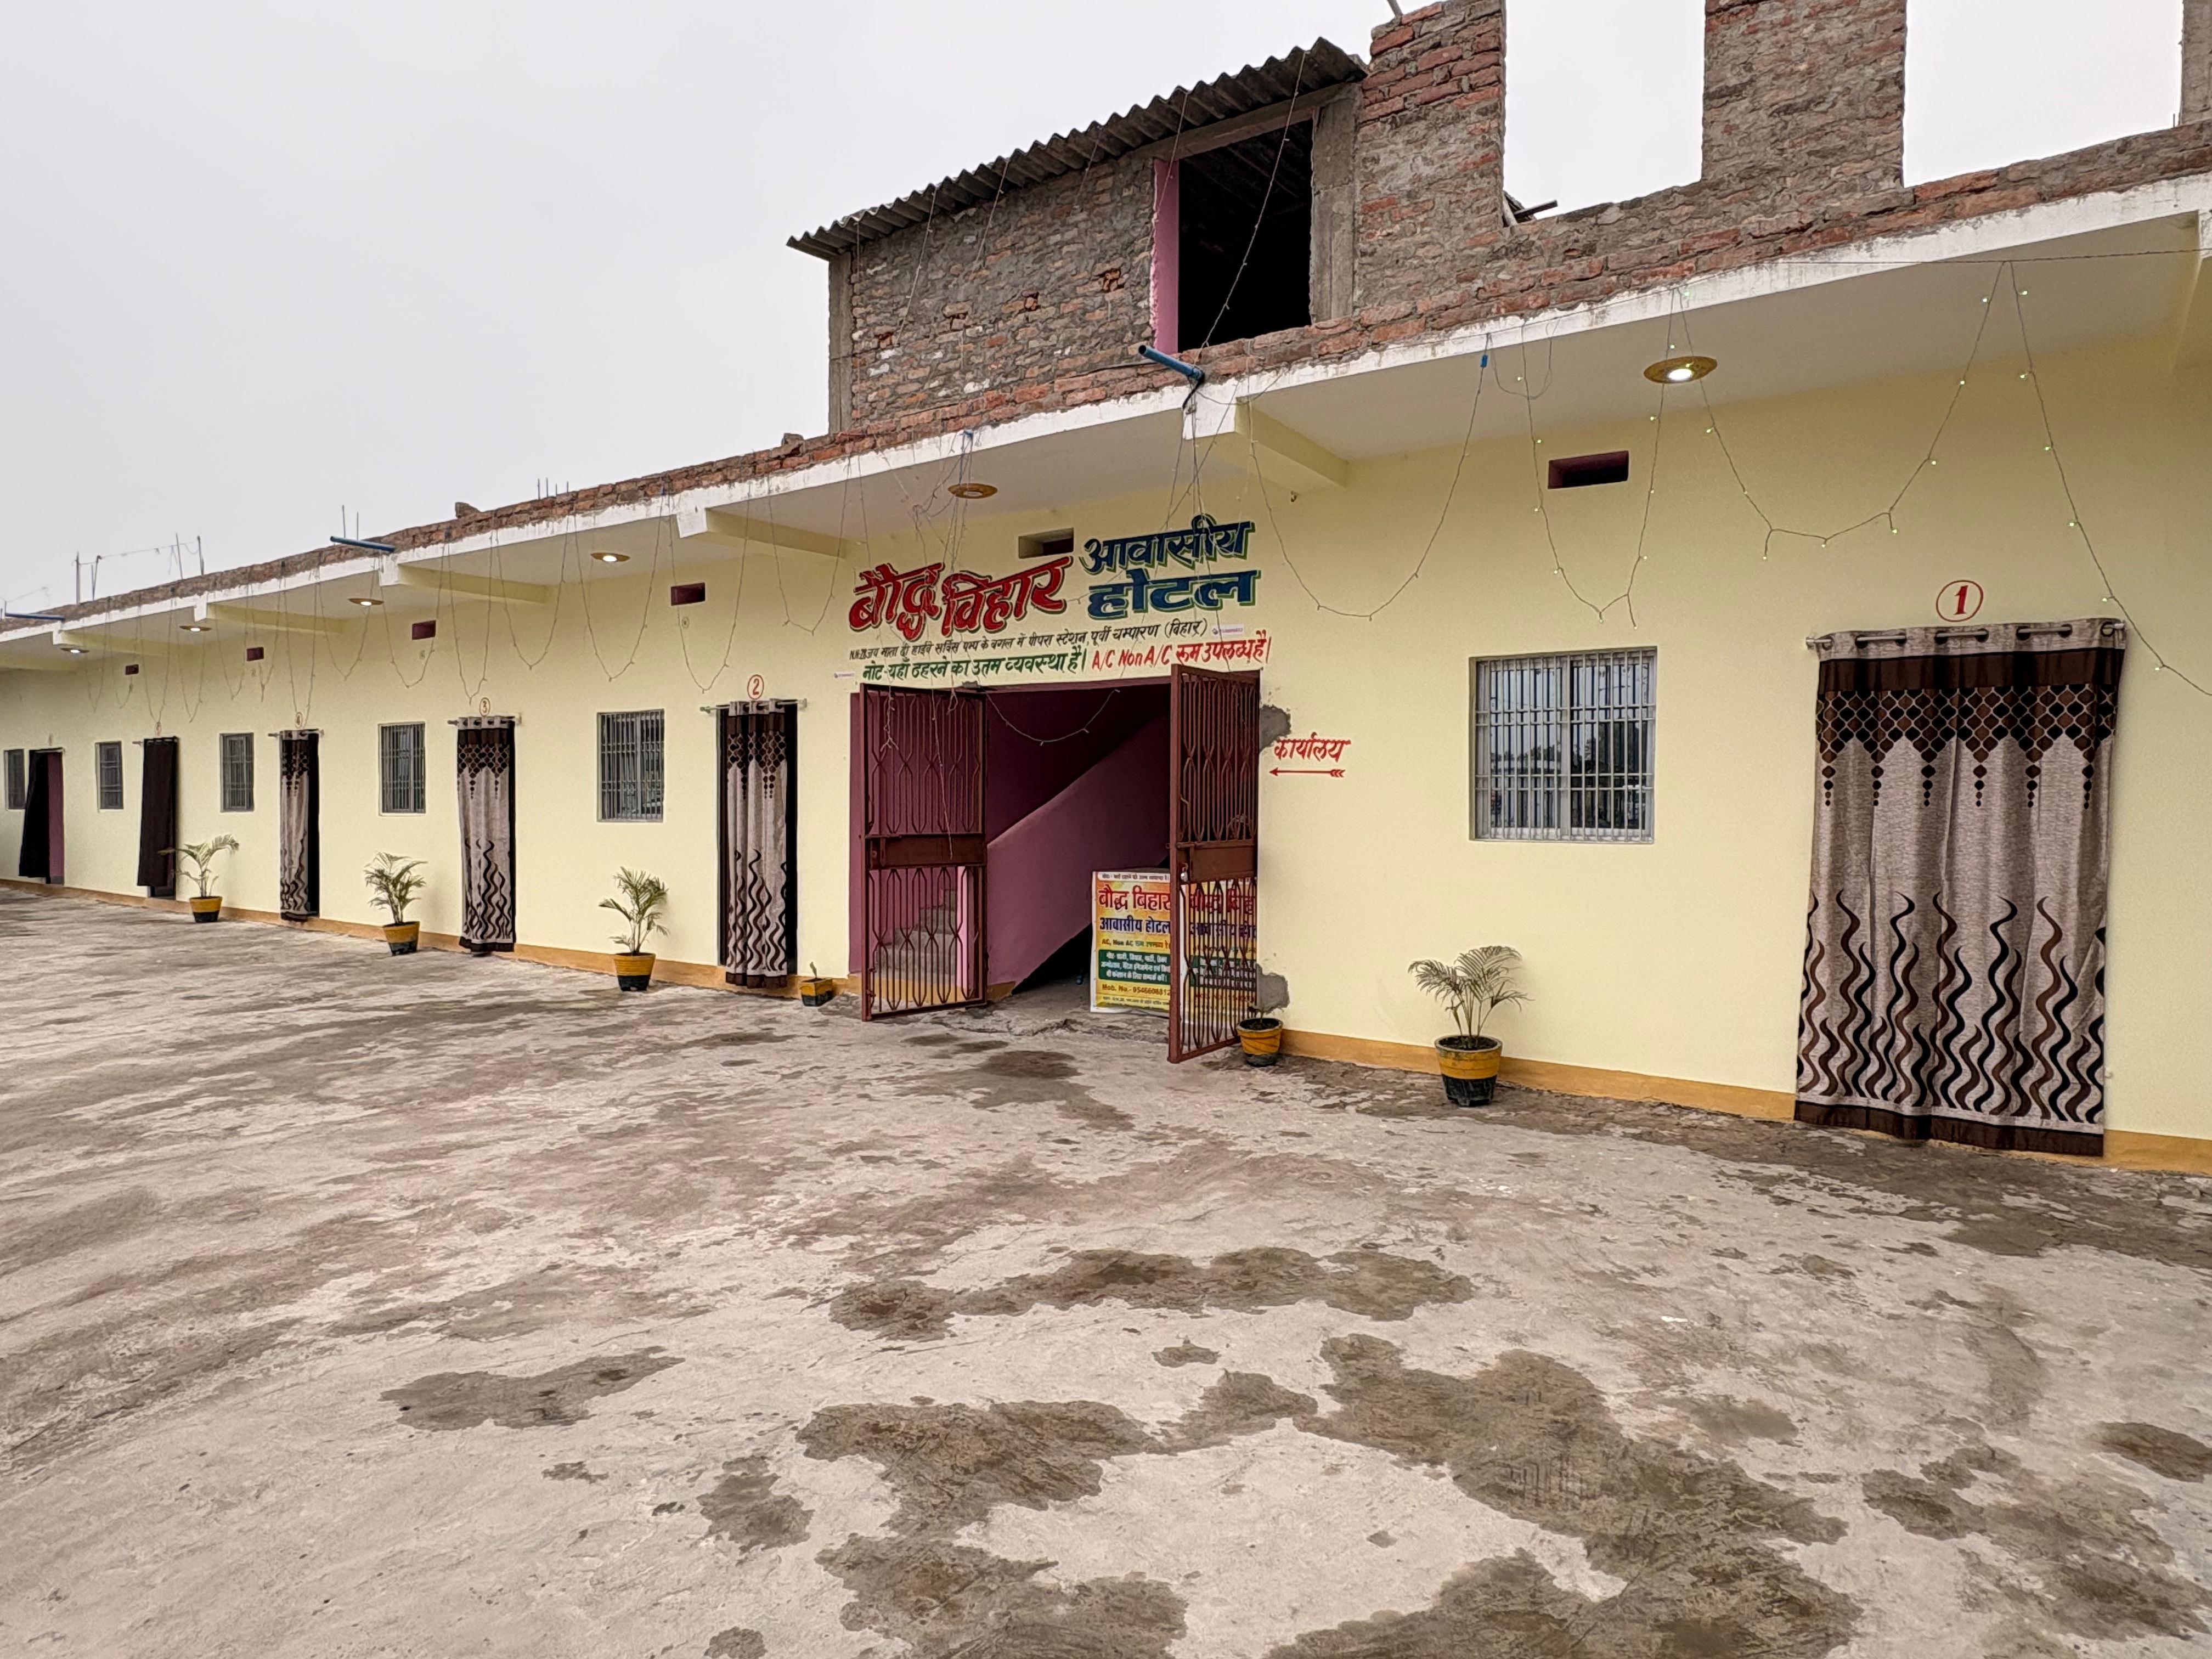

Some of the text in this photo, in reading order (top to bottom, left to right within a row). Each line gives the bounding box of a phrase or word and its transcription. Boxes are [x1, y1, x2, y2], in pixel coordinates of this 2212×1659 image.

[1079, 512, 1256, 575] आवासीय
[849, 562, 945, 642] बौद्ध
[1087, 568, 1262, 620] होटल
[1954, 585, 1969, 616] 1
[981, 635, 989, 650] के
[1017, 633, 1028, 648] में
[1029, 631, 1054, 648] पीपरा
[1112, 624, 1161, 641] चम्पारण
[912, 655, 951, 679] ठहरने
[951, 660, 971, 676] का
[1006, 653, 1068, 674] व्यवस्था
[1092, 645, 1172, 672] A/C Non A/C
[753, 678, 760, 695] 2
[1274, 732, 1352, 763] कार्यालय
[1099, 915, 1143, 932] आवासीय
